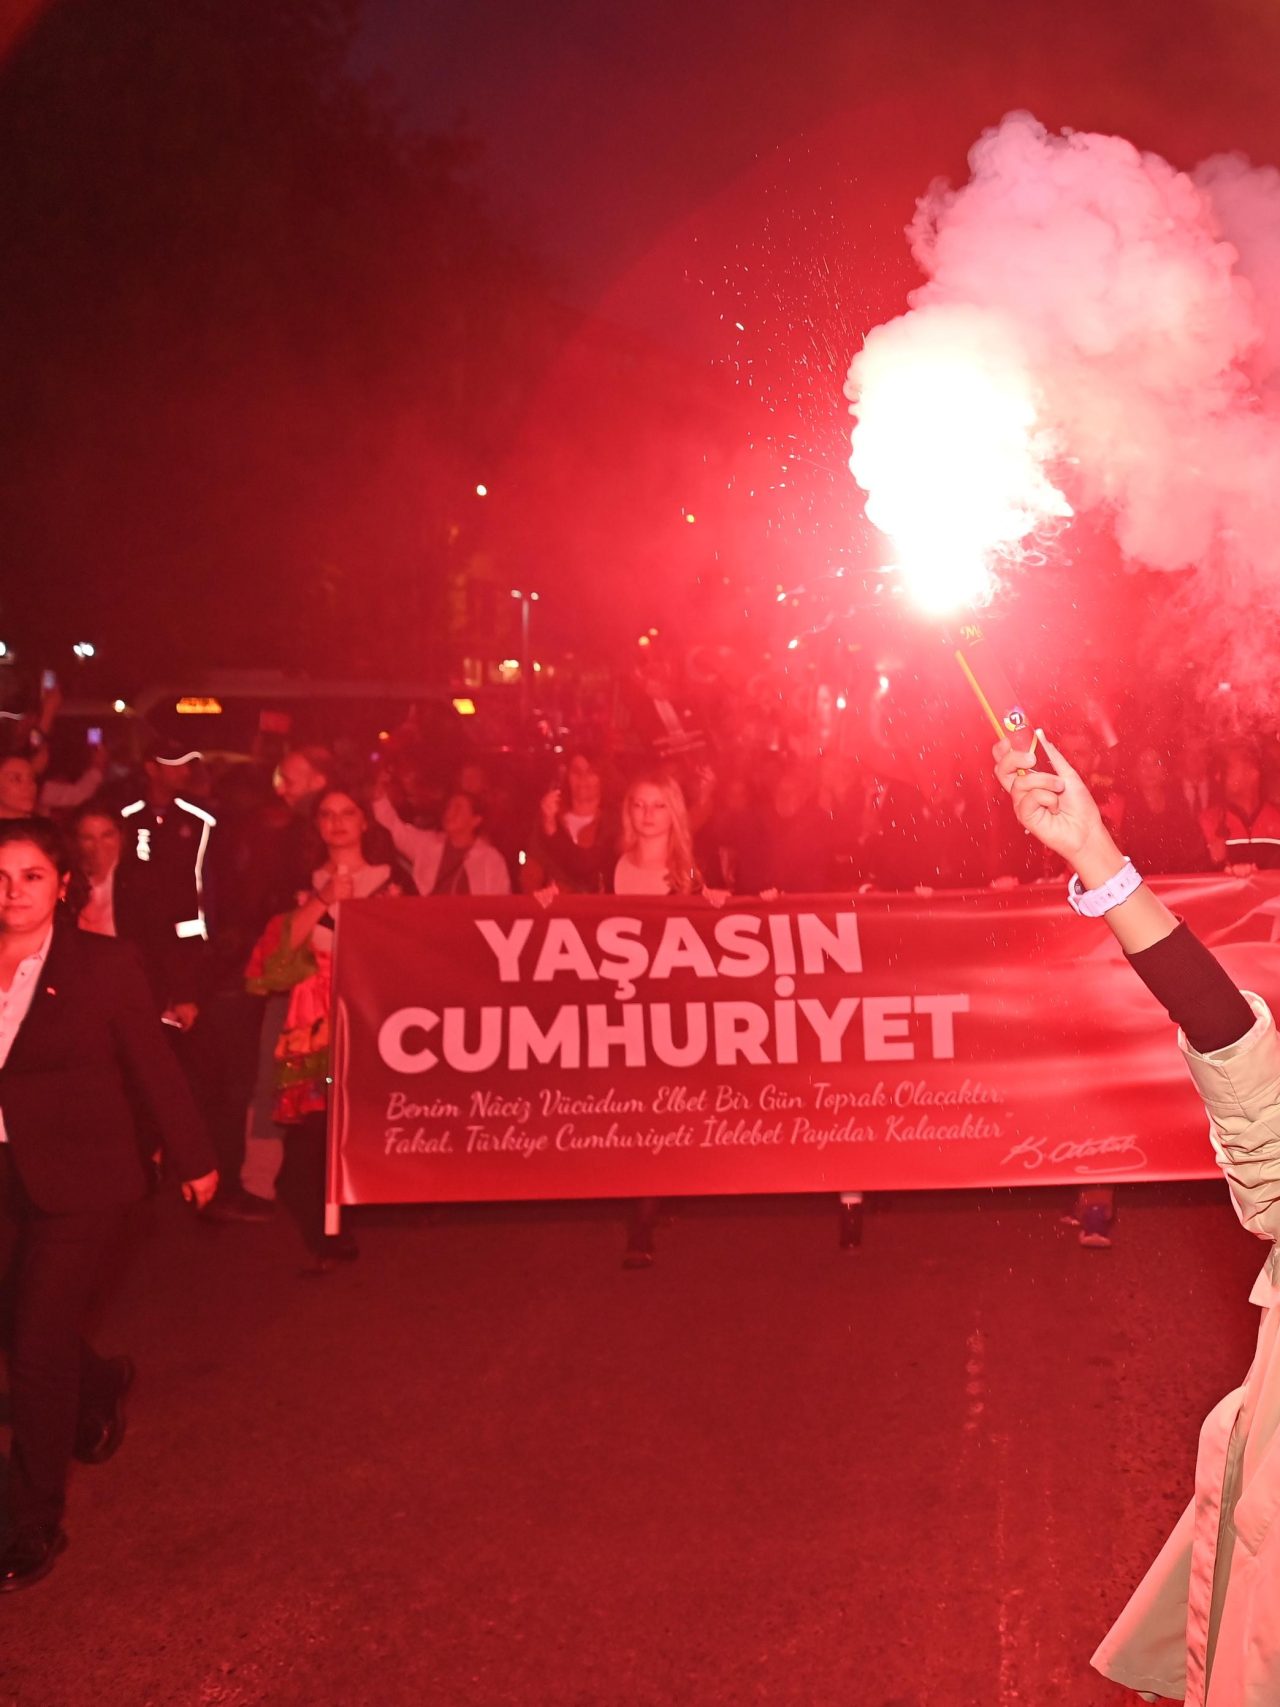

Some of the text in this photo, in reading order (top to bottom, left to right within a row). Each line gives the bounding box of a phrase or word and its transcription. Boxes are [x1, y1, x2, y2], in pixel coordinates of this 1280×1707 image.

[475, 912, 863, 1000] YAŞASIN
[378, 975, 970, 1074] CUMHURİYET
[386, 1091, 461, 1120] Benim
[652, 1085, 707, 1115] Elbet
[715, 1084, 751, 1113] Bir
[759, 1083, 803, 1112] Gün
[813, 1081, 886, 1115] Toprak
[466, 1123, 548, 1159] Türkiye
[555, 1122, 694, 1155] Cumhuriyeti
[701, 1115, 783, 1148] İlelebet
[790, 1116, 876, 1150] Payidar
